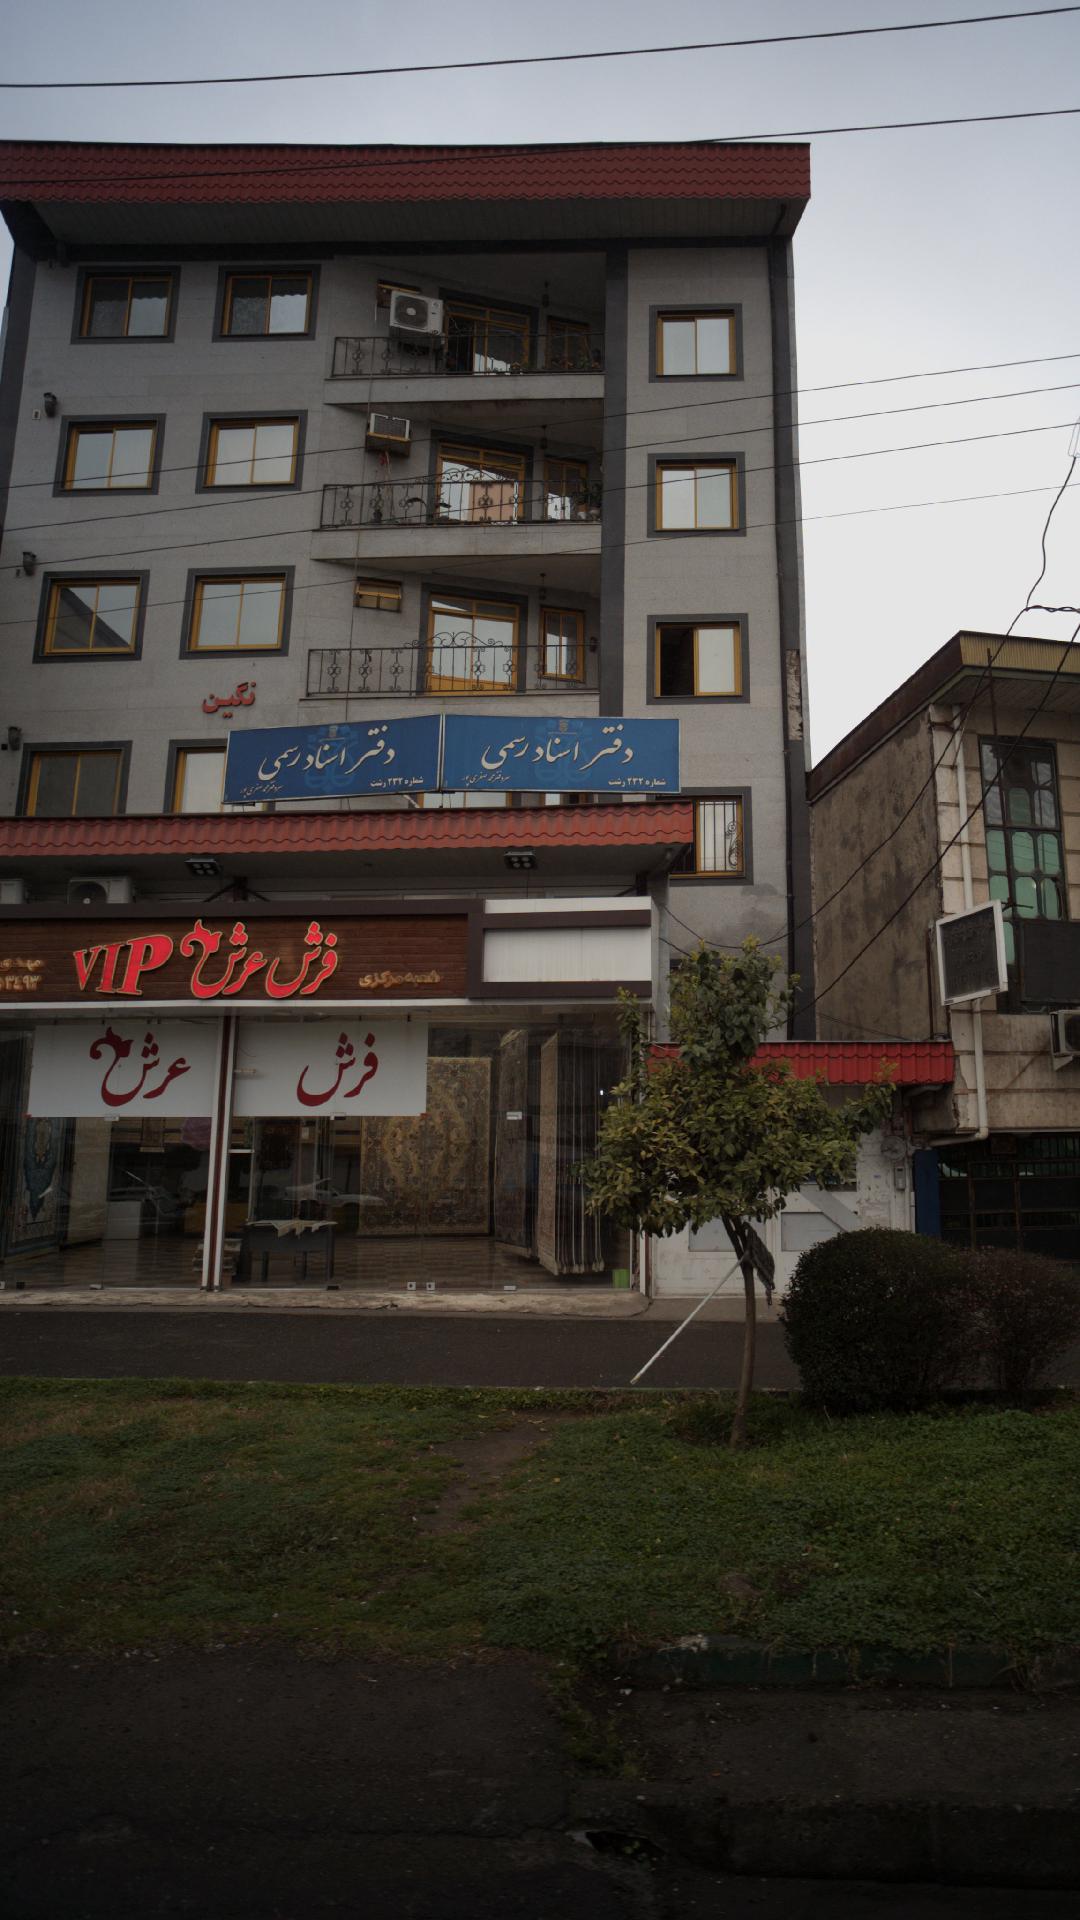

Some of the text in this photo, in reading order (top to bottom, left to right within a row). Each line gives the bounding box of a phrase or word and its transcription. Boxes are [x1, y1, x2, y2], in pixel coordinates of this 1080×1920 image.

[202, 681, 256, 719] نگین
[257, 724, 396, 781] دفتر اسناد رسمی
[480, 723, 634, 771] دفتر اسناد رسمی
[369, 778, 386, 789] رشت
[404, 775, 424, 787] شماره
[608, 777, 625, 788] رشت
[645, 777, 666, 788] شماره
[73, 934, 174, 996] VIP
[180, 919, 339, 999] فرش عرش
[359, 969, 442, 989] شعبه مرکزی
[89, 1026, 191, 1107] عرش
[296, 1031, 379, 1107] فرش
